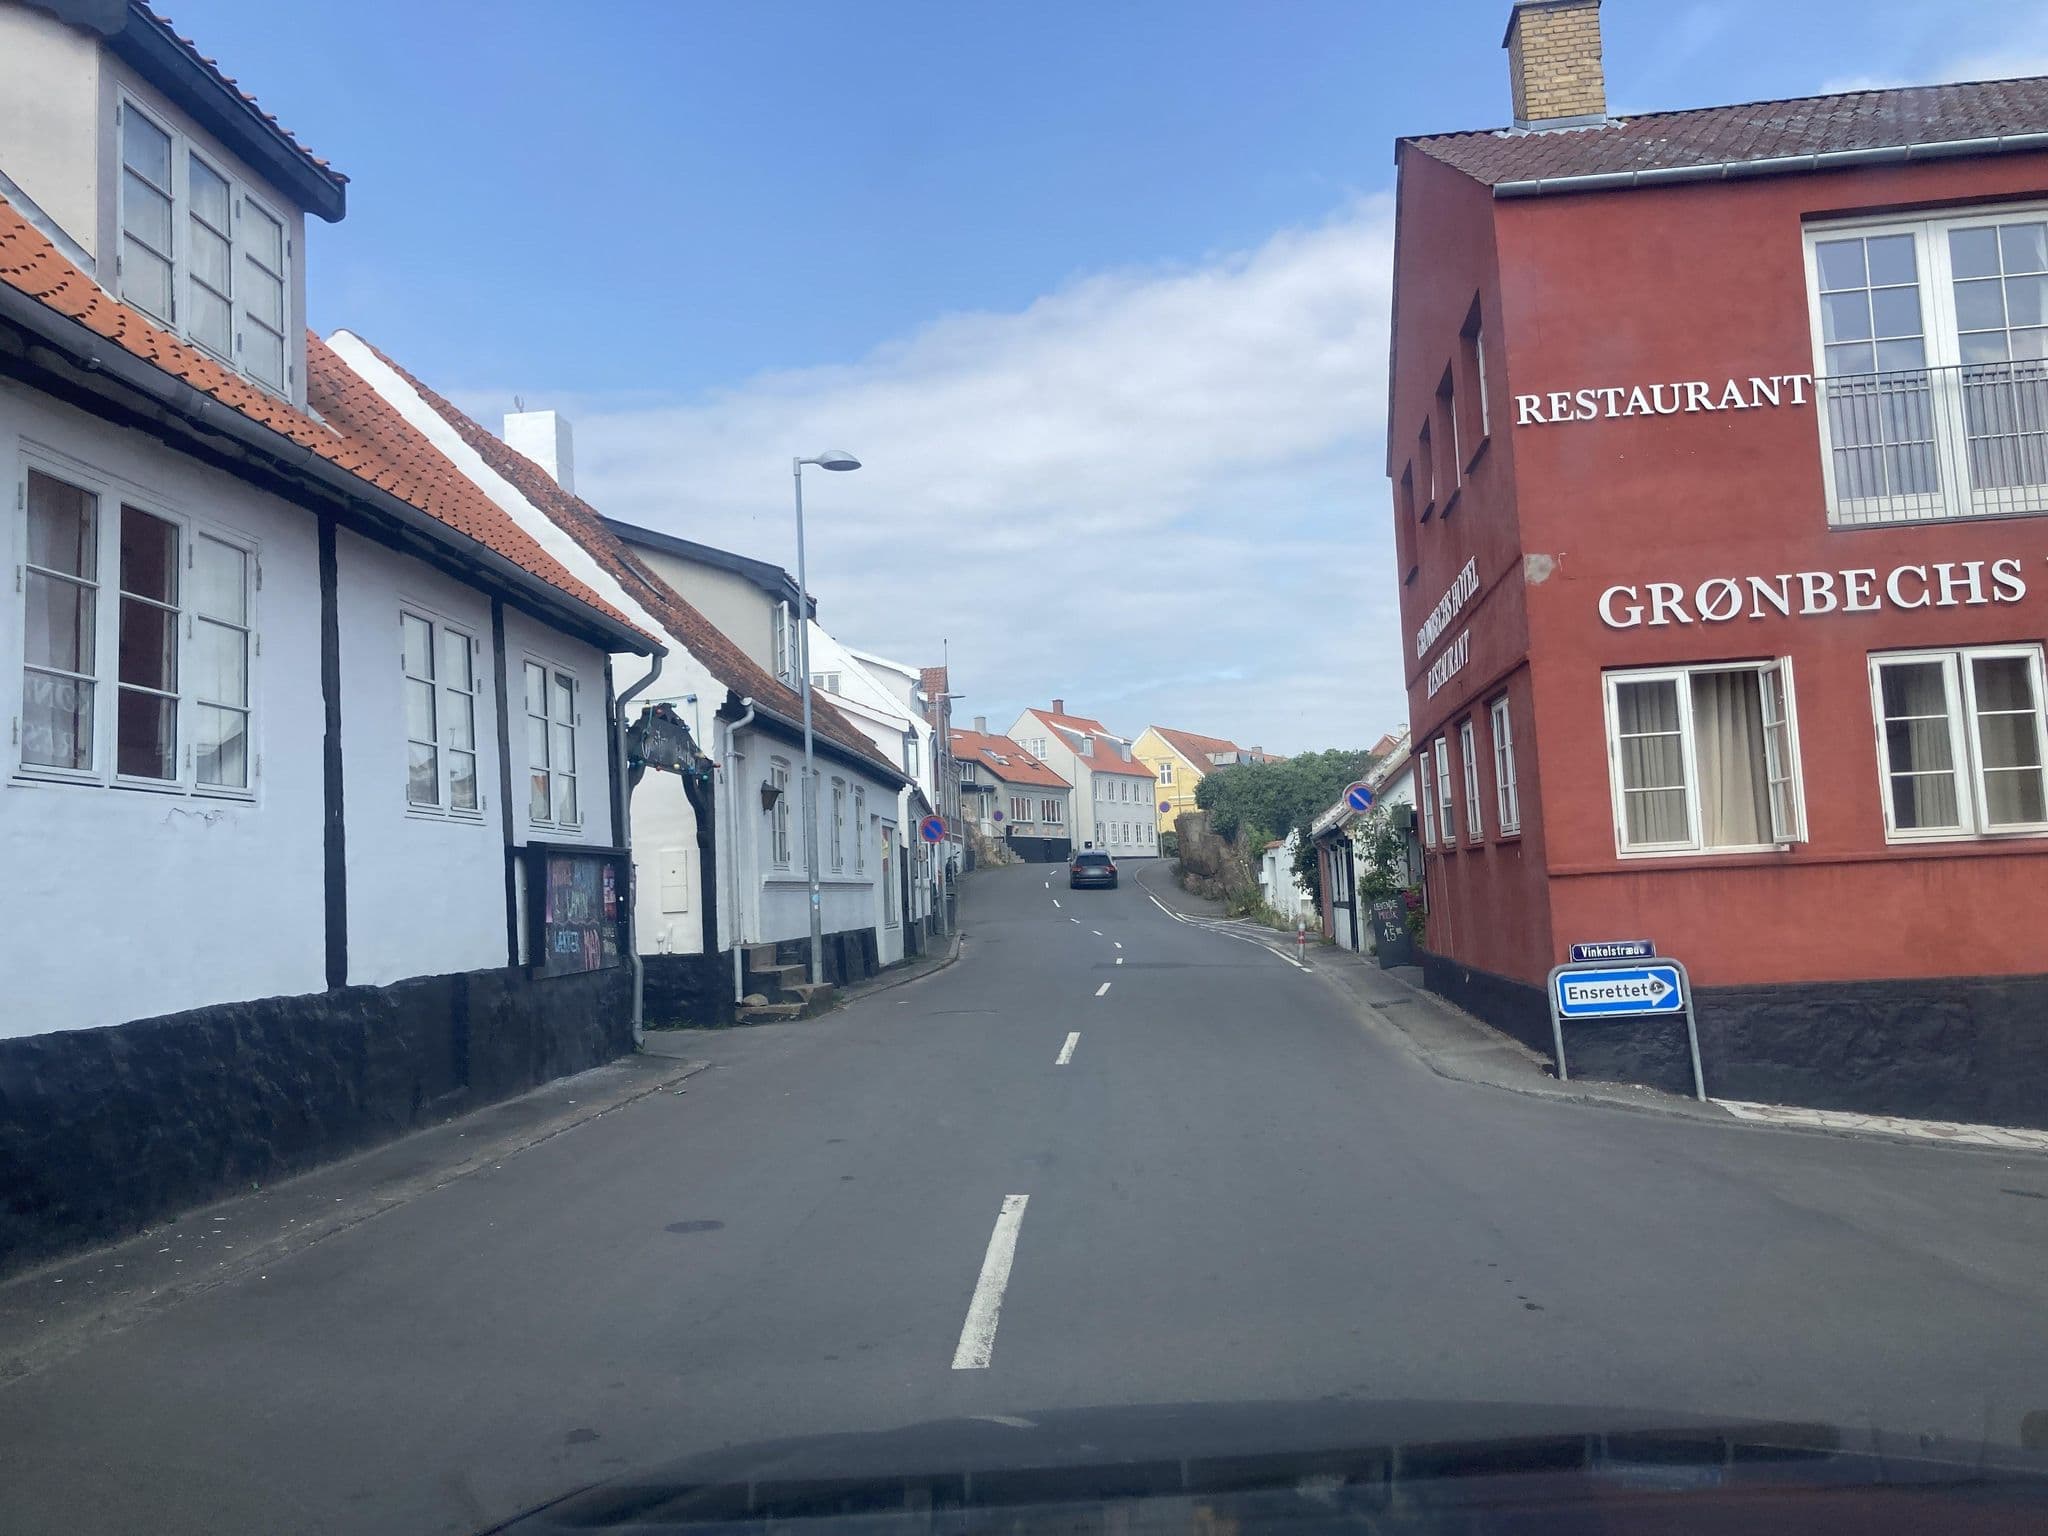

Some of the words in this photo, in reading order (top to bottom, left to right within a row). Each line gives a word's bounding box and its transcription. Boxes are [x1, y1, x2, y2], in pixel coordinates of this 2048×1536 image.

[1515, 374, 1811, 425] RESTAURANT
[1451, 556, 1479, 617] HOTEL
[1599, 559, 2027, 628] GRØNBECHS
[1568, 983, 1648, 1000] Ensrettet
